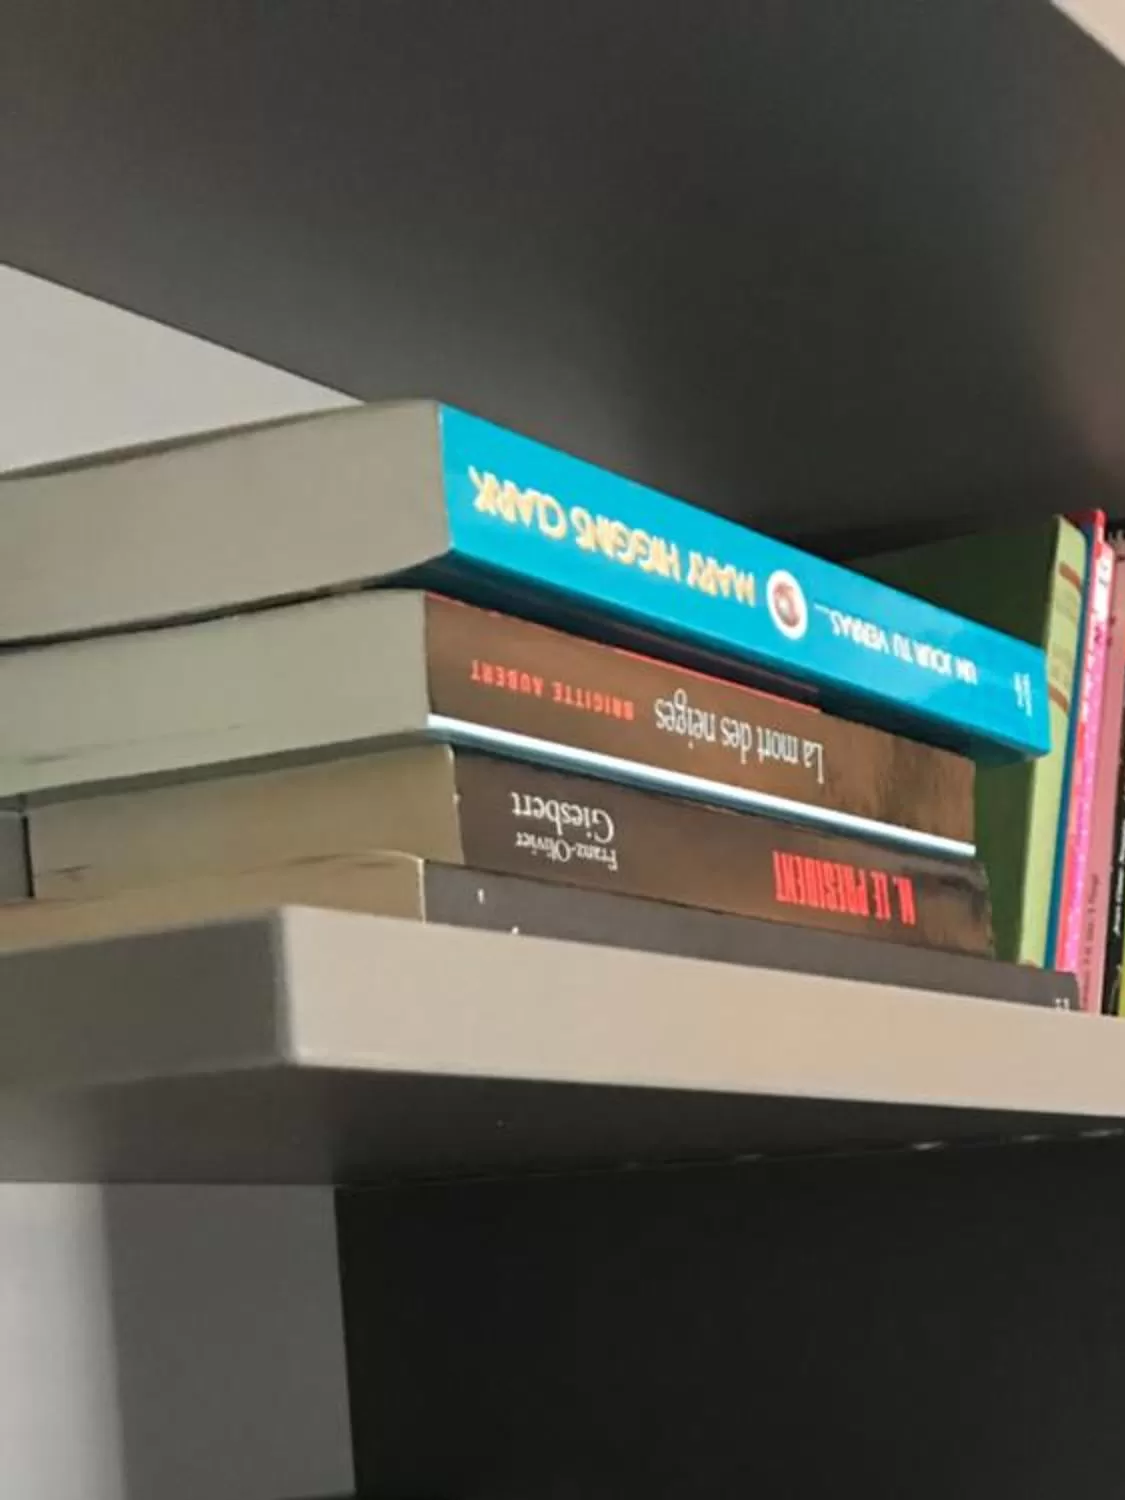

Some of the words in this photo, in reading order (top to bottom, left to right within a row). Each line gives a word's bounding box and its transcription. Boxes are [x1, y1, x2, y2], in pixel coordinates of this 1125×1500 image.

[468, 464, 567, 540] CLARK
[570, 505, 681, 583] HIGGINS
[686, 551, 756, 608] MARY
[470, 659, 544, 697] AUBERT
[551, 680, 635, 721] BRIGITTE
[654, 688, 715, 749] neiges
[720, 716, 752, 765] des
[755, 721, 800, 765] mort
[803, 740, 824, 784] La
[511, 791, 615, 843] Giesbert
[515, 831, 619, 871] Franz-Olivier
[869, 870, 891, 920] LE
